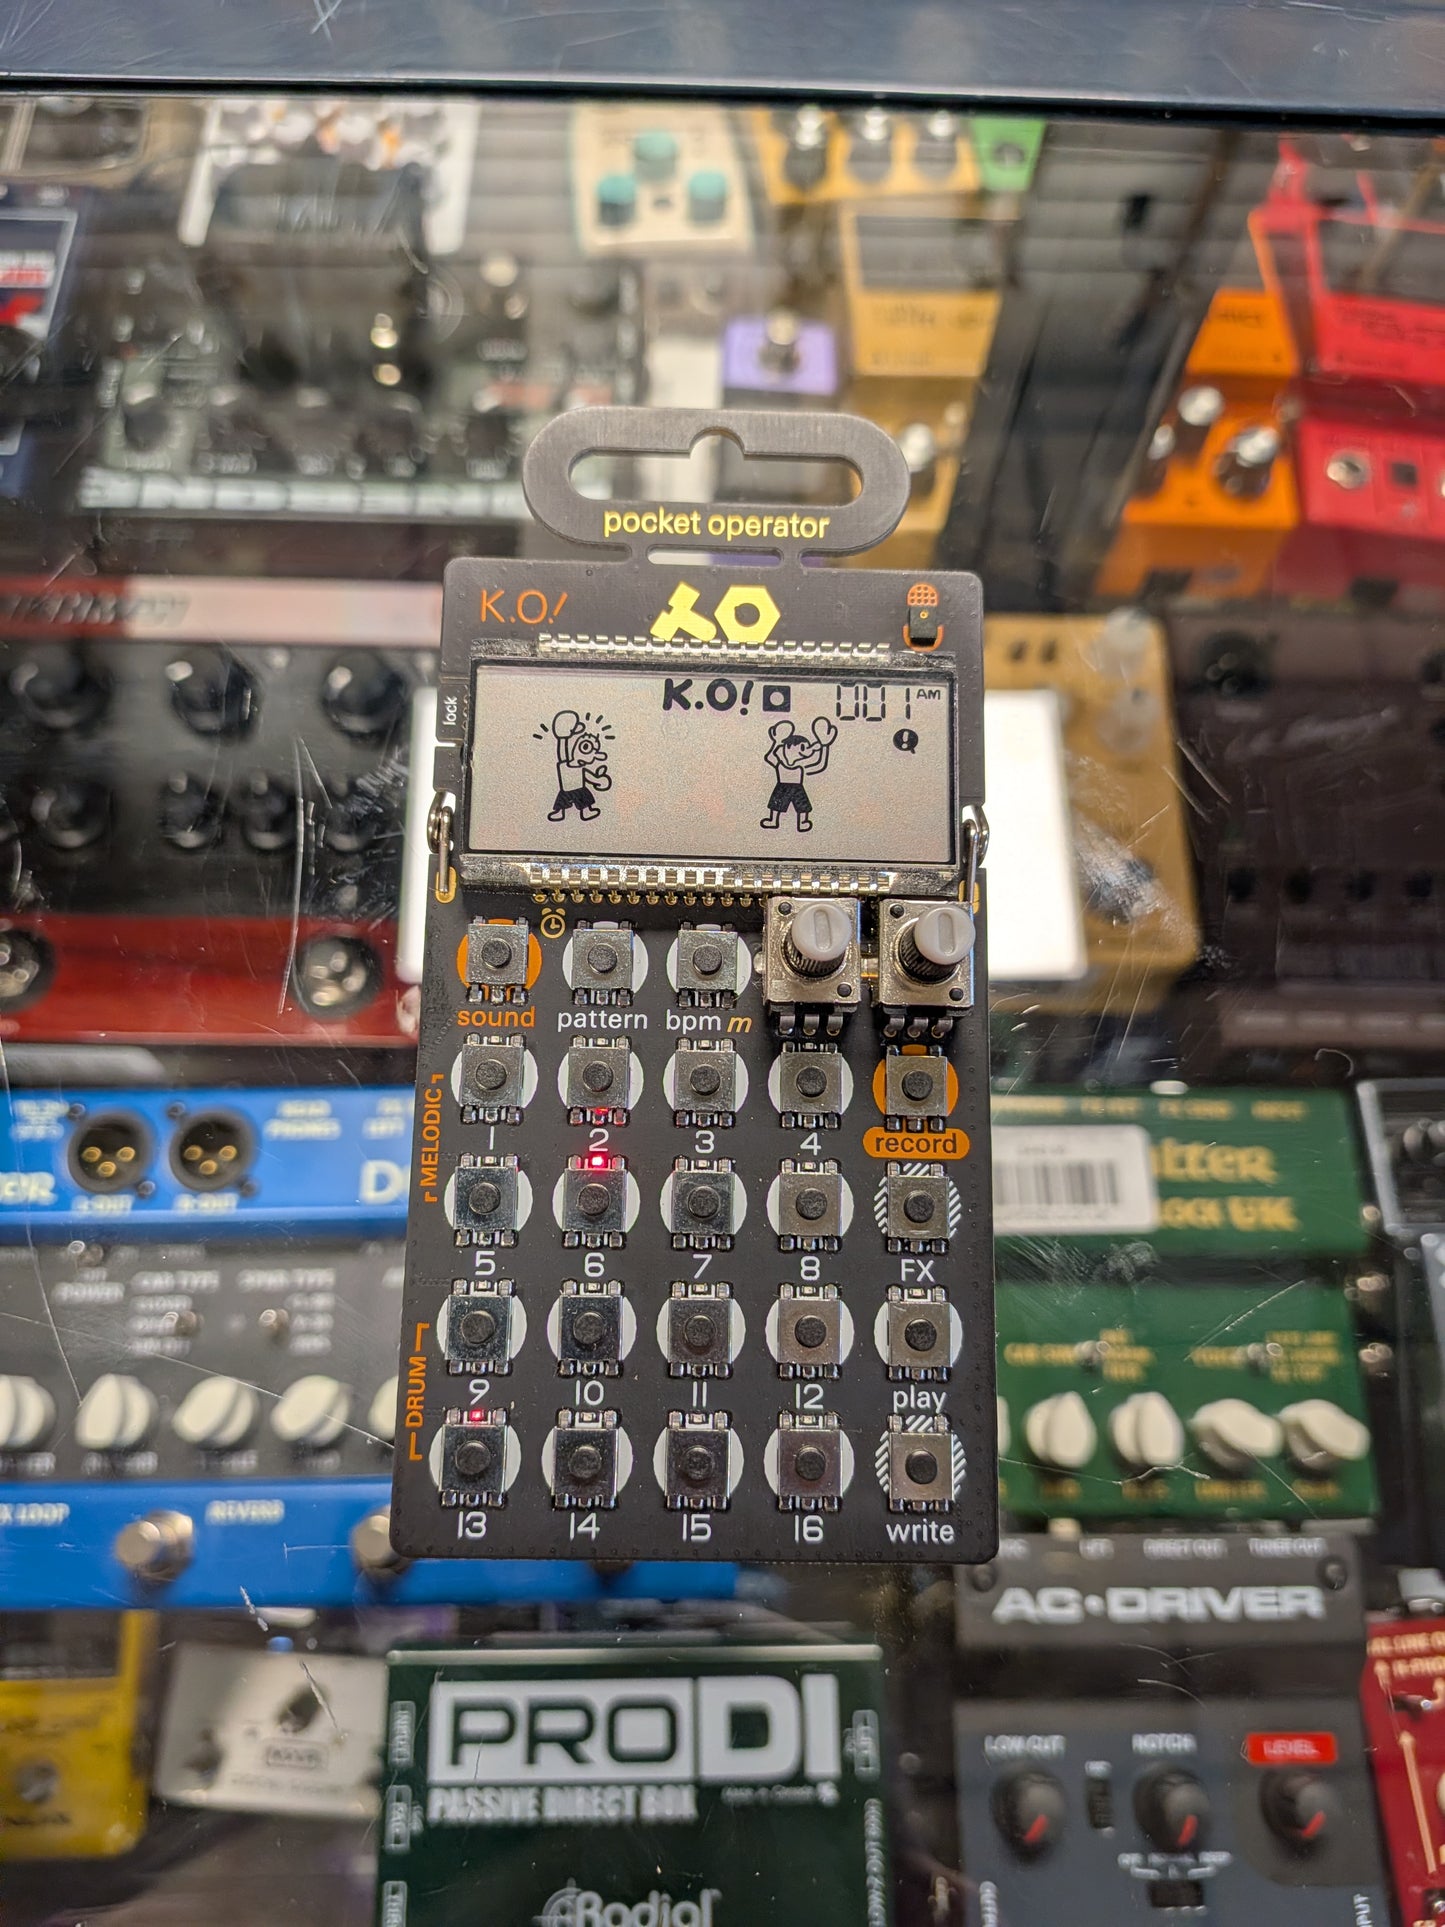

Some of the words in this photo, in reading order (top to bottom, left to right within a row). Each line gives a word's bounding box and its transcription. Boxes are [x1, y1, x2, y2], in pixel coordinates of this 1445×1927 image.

[603, 506, 702, 538] pocket
[706, 512, 831, 543] operator
[479, 588, 569, 626] K.O!
[661, 677, 755, 717] K.O!
[916, 688, 942, 701] AM
[442, 694, 458, 726] lock
[456, 1005, 536, 1029] sound
[557, 1008, 649, 1033] pattern
[666, 1008, 722, 1035] bpm
[418, 1087, 444, 1189] MELODIC
[489, 1125, 496, 1152] 1
[588, 1127, 611, 1153] 2
[694, 1130, 716, 1155] 3
[799, 1132, 823, 1156] 4
[874, 1133, 958, 1156] record
[474, 1250, 497, 1277] 5
[583, 1252, 606, 1278] 6
[691, 1253, 714, 1279] 7
[799, 1255, 822, 1282] 8
[900, 1258, 936, 1284] FX
[403, 1355, 429, 1429] DRUM
[467, 1378, 491, 1407] 9
[574, 1379, 606, 1406] 10
[692, 1381, 708, 1408] 11
[795, 1382, 825, 1410] 12
[892, 1387, 948, 1415] play
[456, 1511, 488, 1539] 13
[568, 1512, 602, 1540] 14
[681, 1513, 713, 1541] 15
[794, 1514, 825, 1542] 16
[886, 1517, 956, 1543] write
